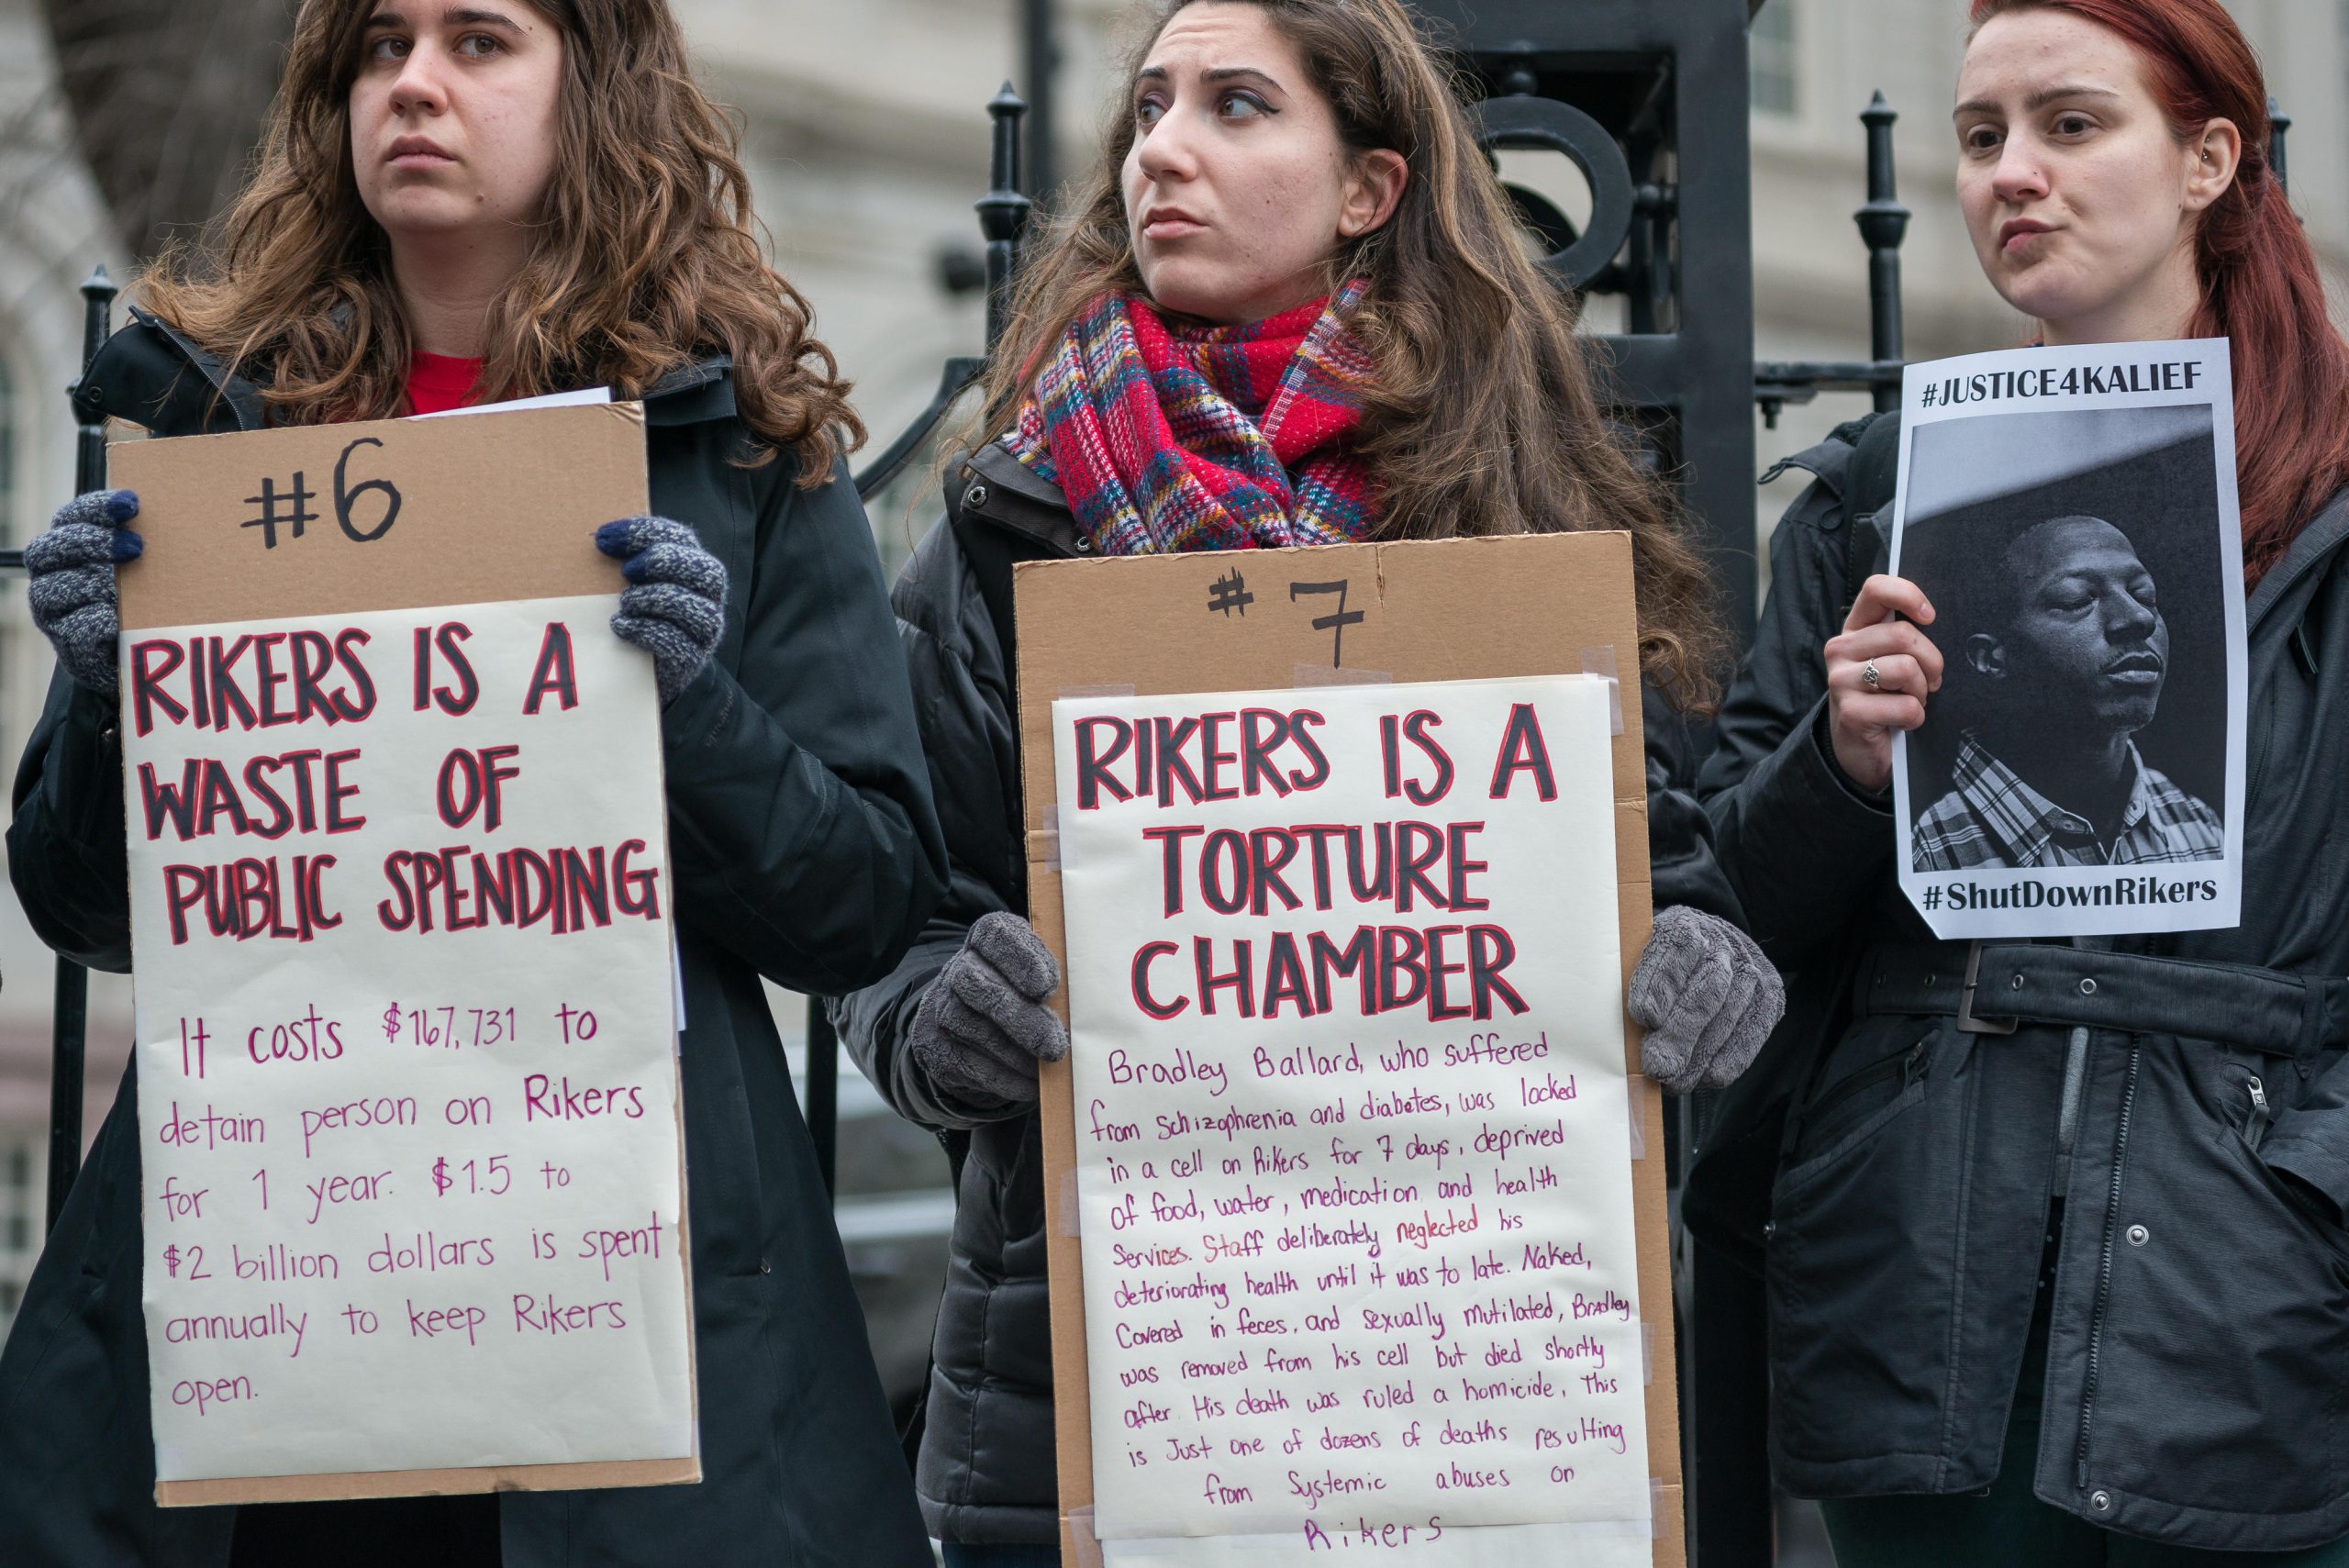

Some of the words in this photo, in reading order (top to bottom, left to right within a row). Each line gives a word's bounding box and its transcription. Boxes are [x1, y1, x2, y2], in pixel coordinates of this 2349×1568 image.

[1921, 361, 2201, 408] #JUSTICE4KALIEF
[240, 437, 402, 549] #6
[130, 628, 377, 738] RIKERS
[413, 622, 479, 716] IS
[522, 622, 578, 715] A
[1074, 707, 1330, 810] RIKERS
[1380, 709, 1454, 806] IS
[1489, 703, 1558, 801] A
[137, 749, 366, 841] WASTE
[437, 744, 520, 833] OF
[164, 854, 342, 945] PUBLIC
[377, 840, 661, 935] SPENDING
[1142, 821, 1489, 918] TORTURE
[1922, 877, 2217, 910] #ShutDownRikers
[1131, 924, 1531, 1022] CHAMBER
[181, 1017, 211, 1079] It
[248, 1003, 343, 1064] costs
[382, 1001, 514, 1050] $167,731
[554, 1003, 596, 1044] to
[1108, 1048, 1228, 1096] Bradley
[1253, 1042, 1364, 1078] Ballard,
[1380, 1040, 1429, 1073] who
[1444, 1031, 1548, 1066] suffered
[160, 1101, 264, 1151] detain
[301, 1097, 416, 1159] person
[445, 1096, 491, 1125] on
[524, 1073, 644, 1122] Rikers
[1090, 1099, 1141, 1143] from
[1310, 1097, 1345, 1125] and
[1360, 1087, 1450, 1120] diabetes,
[1459, 1092, 1495, 1112] was
[1520, 1073, 1576, 1106] locked
[1107, 1157, 1130, 1184] in
[1141, 1162, 1158, 1179] a
[1171, 1149, 1204, 1178] cell
[1222, 1162, 1241, 1174] on
[1330, 1137, 1363, 1166] for
[1376, 1135, 1394, 1162] 7
[1406, 1134, 1464, 1170] days,
[1474, 1118, 1564, 1161] deprived
[159, 1176, 209, 1222] for
[251, 1169, 267, 1210] 1
[306, 1171, 393, 1225] year.
[432, 1154, 510, 1197] $1.5
[540, 1161, 570, 1190] to
[1151, 1189, 1204, 1222] food,
[1213, 1184, 1288, 1217] water,
[1300, 1176, 1418, 1209] medication
[1438, 1173, 1472, 1199] and
[1495, 1165, 1557, 1195] health
[162, 1243, 211, 1280] $2
[232, 1243, 338, 1281] billion
[368, 1231, 495, 1273] dollars
[532, 1229, 556, 1259] is
[578, 1210, 662, 1282] spent
[1202, 1229, 1264, 1263] Staff
[1277, 1218, 1381, 1259] deliberately
[1397, 1204, 1478, 1250] neglected
[1499, 1208, 1523, 1231] his
[1114, 1273, 1230, 1310] deteriorating
[1245, 1270, 1298, 1296] health
[1317, 1263, 1356, 1292] until
[1371, 1262, 1386, 1289] it
[1397, 1267, 1429, 1287] was
[1435, 1256, 1460, 1286] to
[1473, 1250, 1510, 1281] late.
[1522, 1241, 1591, 1271] Naked,
[165, 1302, 307, 1358] annually
[340, 1304, 378, 1335] to
[406, 1299, 485, 1346] keep
[513, 1294, 626, 1335] Rikers
[1210, 1316, 1226, 1339] in
[1236, 1307, 1297, 1336] feces,
[1305, 1305, 1340, 1331] and
[1364, 1302, 1445, 1340] sexually
[1119, 1365, 1159, 1387] was
[1181, 1351, 1249, 1380] removed
[1264, 1348, 1312, 1373] from
[1332, 1342, 1361, 1371] his
[1377, 1342, 1408, 1366] cell
[1435, 1342, 1468, 1368] but
[1485, 1339, 1522, 1367] died
[1545, 1335, 1604, 1369] shortly
[172, 1376, 259, 1417] open.
[1193, 1395, 1225, 1422] His
[1235, 1388, 1290, 1416] death
[1307, 1391, 1340, 1413] was
[1363, 1380, 1414, 1408] ruled
[1433, 1388, 1449, 1403] a
[1463, 1371, 1566, 1402] homicide,
[1127, 1442, 1147, 1468] is
[1166, 1435, 1213, 1461] Just
[1230, 1439, 1264, 1457] one
[1283, 1429, 1303, 1455] of
[1319, 1427, 1381, 1451] dozens
[1402, 1421, 1420, 1448] of
[1440, 1419, 1508, 1446] deaths
[1535, 1418, 1626, 1455] resulting
[1204, 1473, 1253, 1505] from
[1436, 1462, 1510, 1490] abuses
[1550, 1465, 1575, 1484] on
[1304, 1516, 1442, 1551] Rikers
